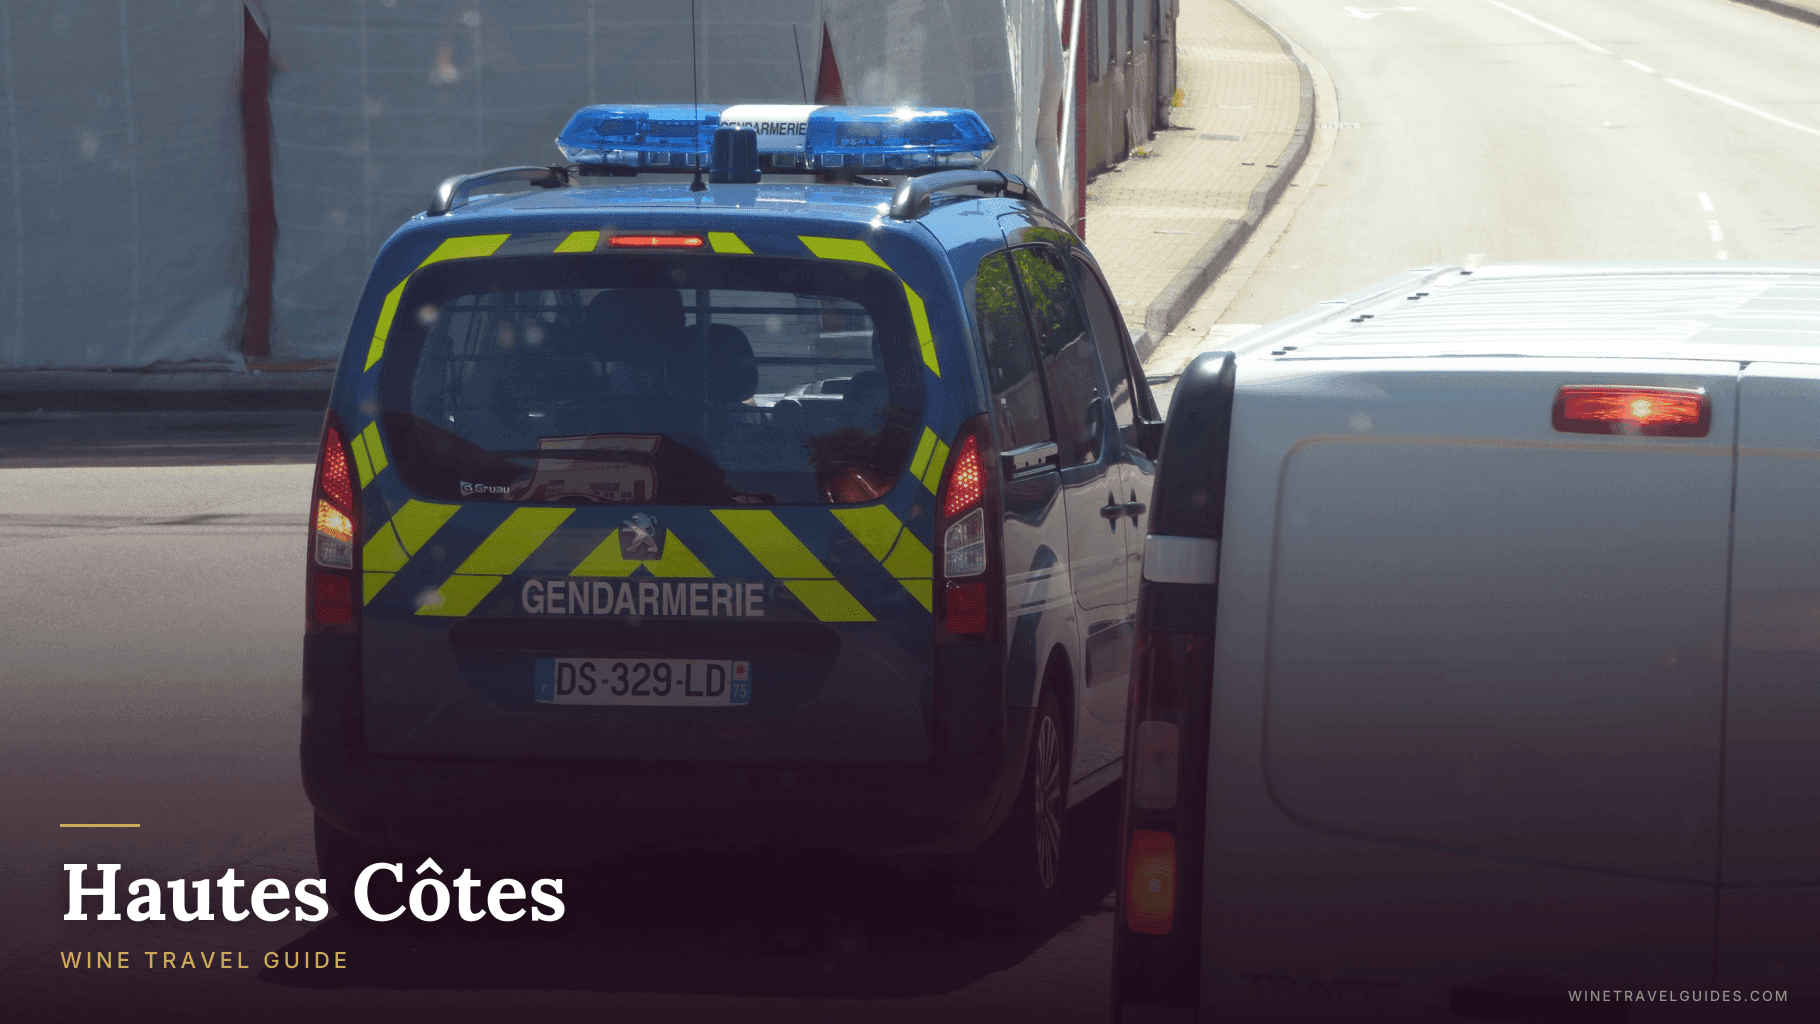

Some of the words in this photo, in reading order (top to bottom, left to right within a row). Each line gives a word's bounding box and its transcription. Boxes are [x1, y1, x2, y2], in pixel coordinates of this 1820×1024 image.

[475, 483, 510, 493] Gruau
[521, 579, 765, 617] GENDARMERIE
[541, 684, 548, 693] F
[556, 662, 726, 697] DS-329-LD
[733, 684, 747, 698] 75
